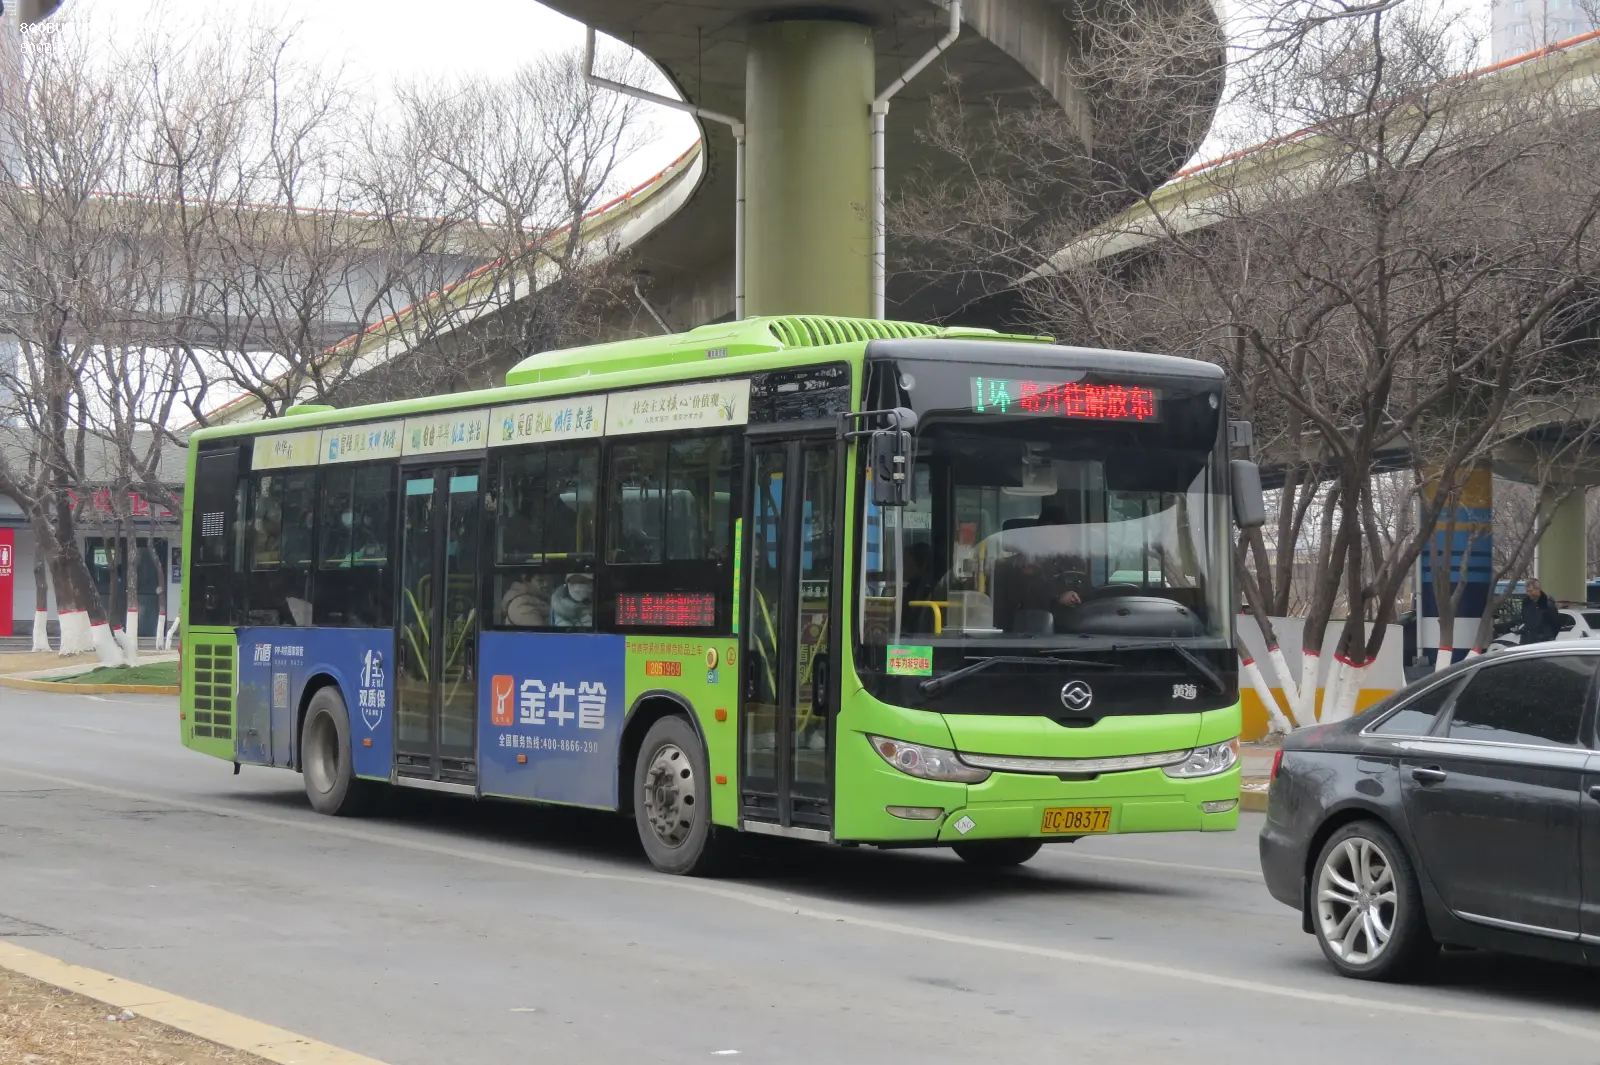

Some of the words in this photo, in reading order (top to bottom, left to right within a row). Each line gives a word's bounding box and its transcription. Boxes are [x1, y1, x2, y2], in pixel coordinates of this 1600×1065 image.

[633, 393, 720, 415] 社会主义核心价值观
[977, 377, 1010, 412] 1环
[650, 662, 680, 675] 2051969
[359, 688, 386, 708] 双质保
[1172, 683, 1198, 700] 黄海
[520, 679, 607, 730] 金牛管
